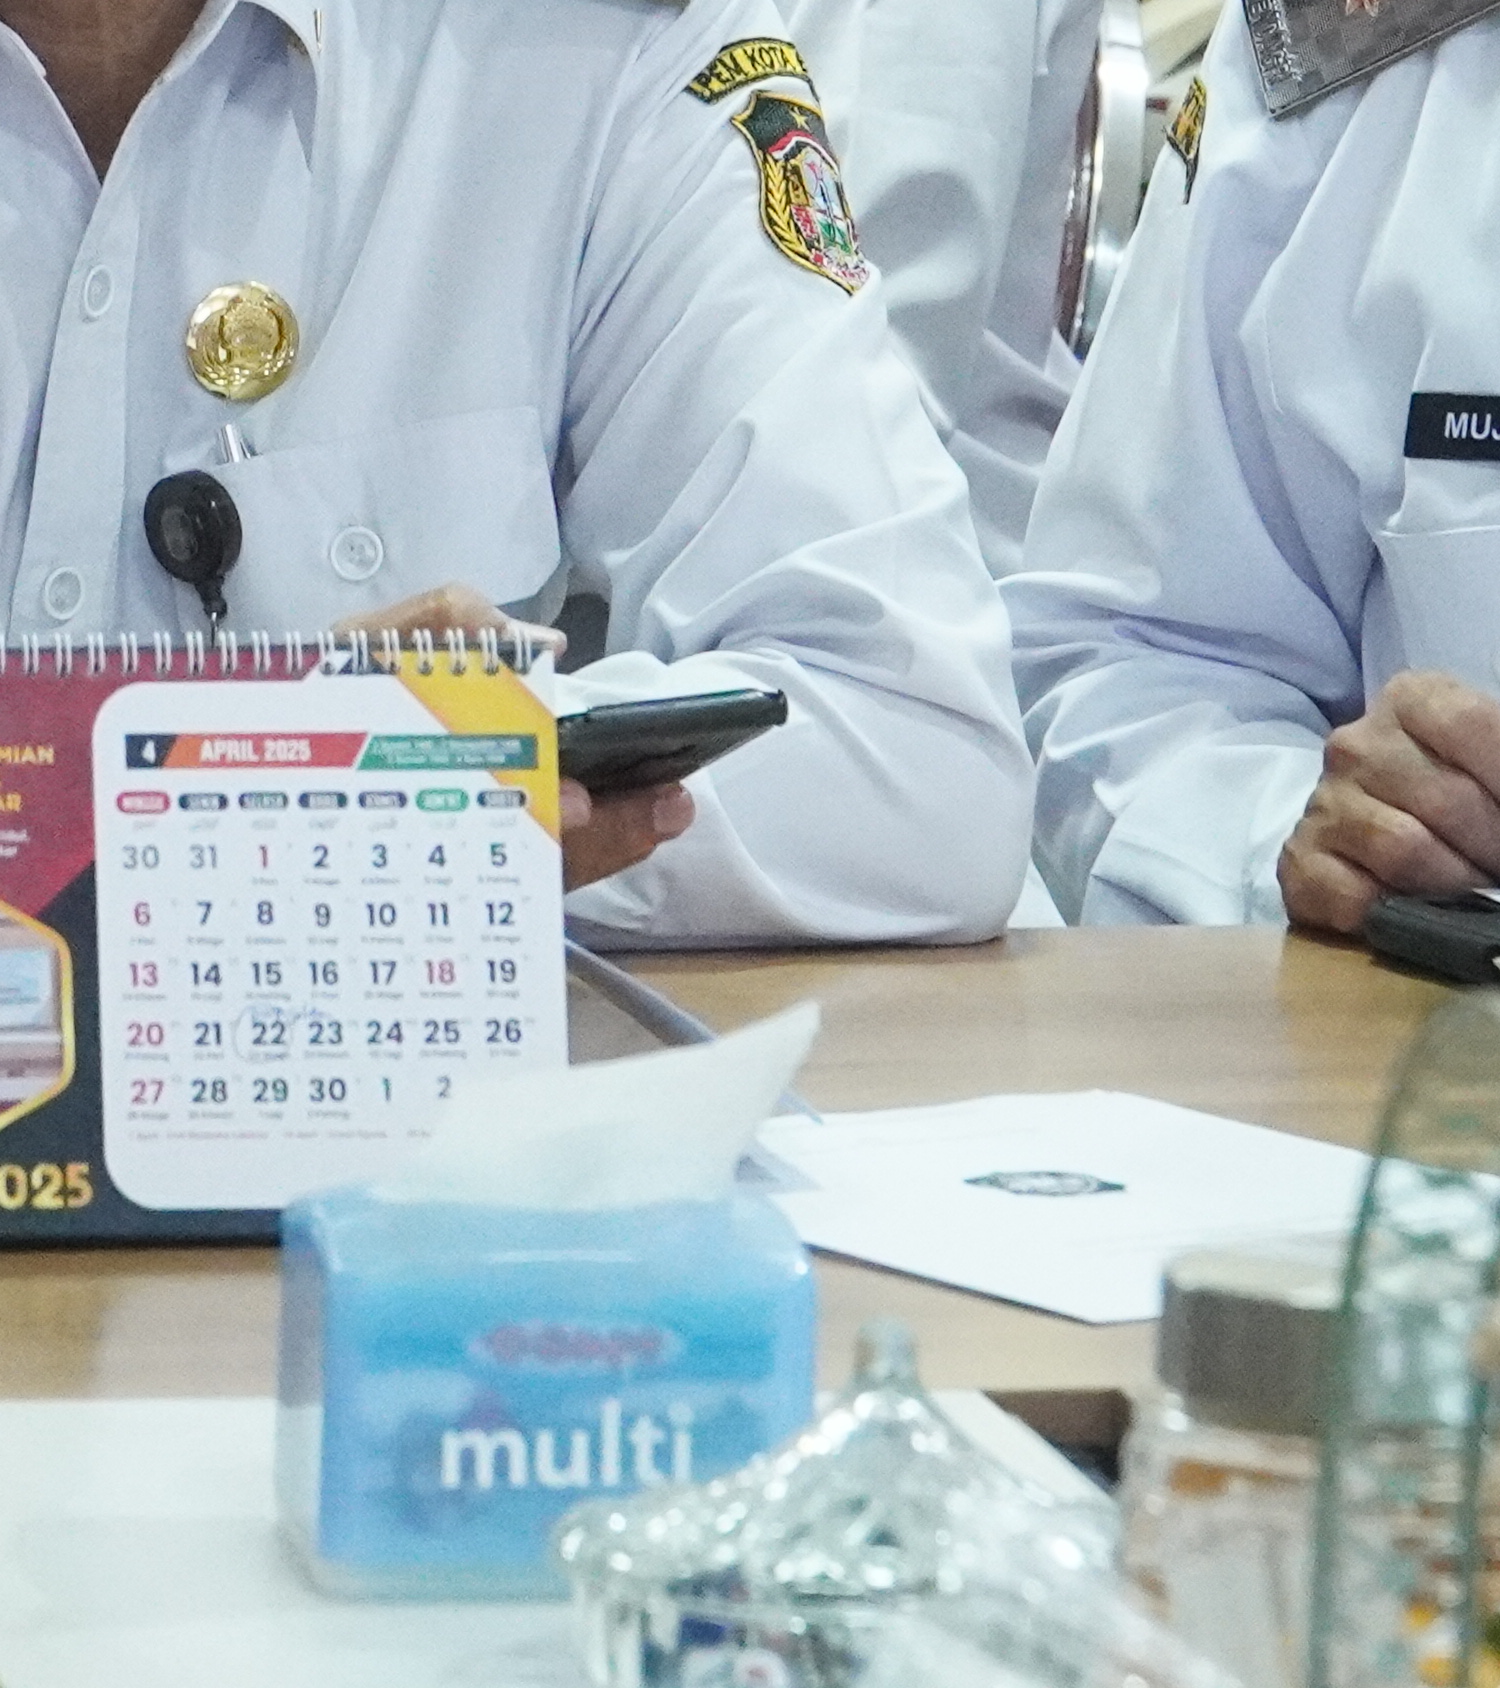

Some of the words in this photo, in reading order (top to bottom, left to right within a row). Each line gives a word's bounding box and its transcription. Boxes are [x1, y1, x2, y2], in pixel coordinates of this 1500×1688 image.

[699, 53, 745, 94] PEM
[746, 45, 793, 74] KOTA
[141, 739, 156, 763] 4
[201, 738, 260, 762] APRIL
[264, 738, 312, 762] 2025
[122, 844, 160, 869] 30
[190, 844, 218, 869] 31
[259, 844, 269, 868] 1
[312, 844, 330, 869] 2
[372, 843, 388, 868] 3
[428, 844, 446, 868] 4
[490, 842, 508, 867] 5
[134, 901, 151, 926] 6
[197, 900, 213, 926] 7
[256, 900, 274, 926] 8
[314, 902, 331, 928] 9
[366, 902, 397, 927] 10
[427, 902, 449, 926] 11
[485, 901, 515, 926] 12
[129, 962, 159, 988] 13
[191, 961, 223, 987] 14
[252, 961, 283, 987] 15
[308, 960, 339, 986] 16
[369, 960, 397, 985] 17
[424, 959, 456, 985] 18
[486, 959, 517, 984] 19
[127, 1021, 164, 1047] 20
[194, 1021, 222, 1047] 21
[252, 1020, 286, 1045] 22
[308, 1020, 343, 1045] 23
[367, 1020, 403, 1045] 24
[424, 1019, 460, 1044] 25
[485, 1018, 522, 1043] 26
[131, 1079, 164, 1105] 27
[191, 1078, 228, 1103] 28
[253, 1078, 289, 1103] 29
[309, 1078, 346, 1102] 30
[382, 1076, 392, 1102] 1
[437, 1075, 452, 1100] 2
[440, 1396, 696, 1490] multi
